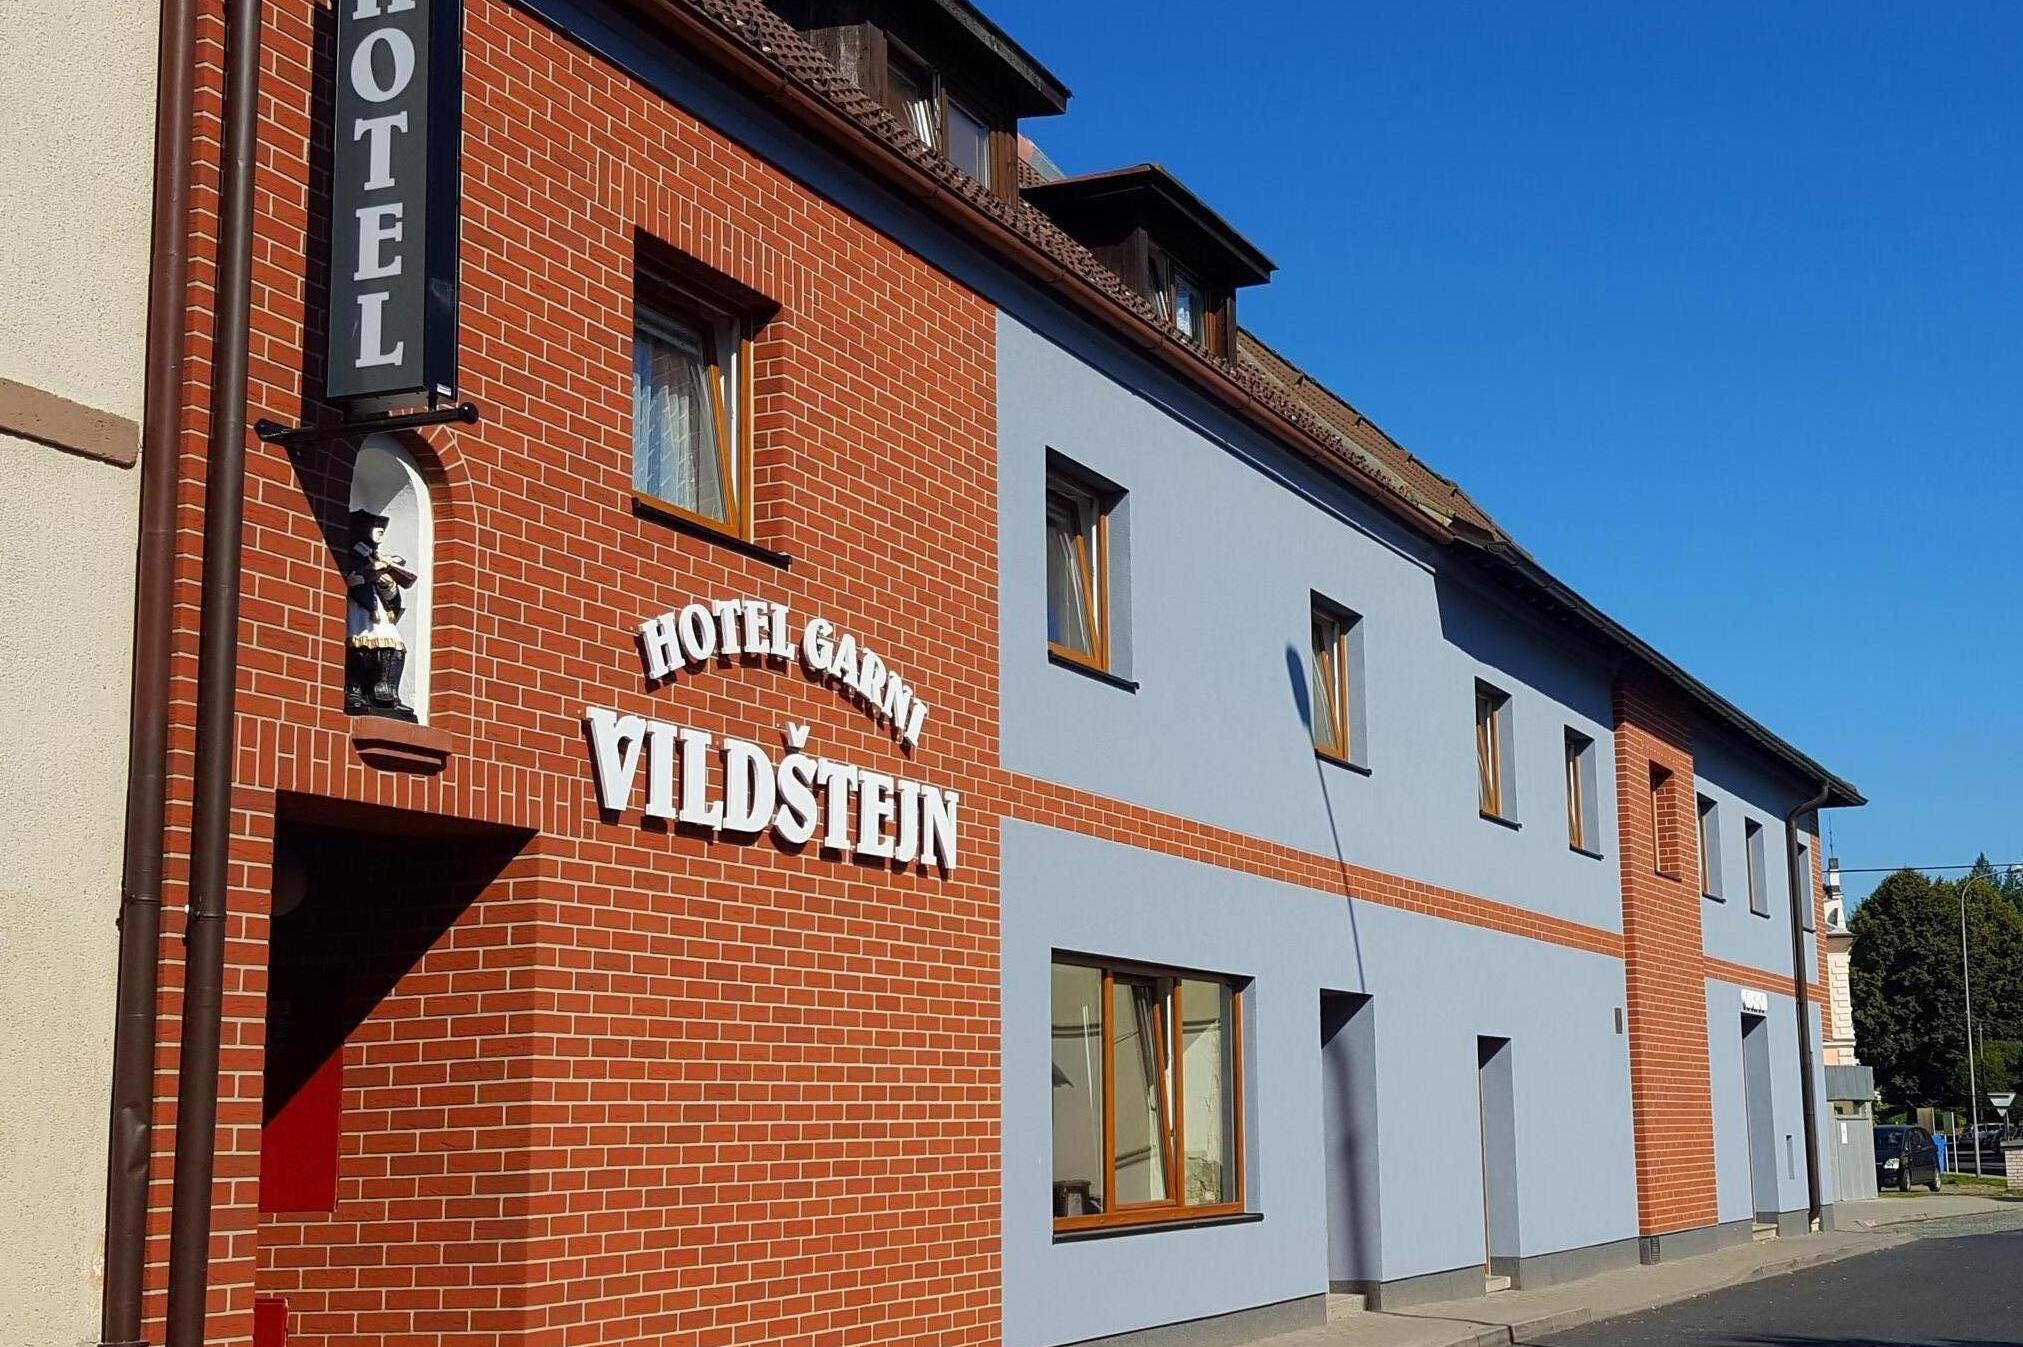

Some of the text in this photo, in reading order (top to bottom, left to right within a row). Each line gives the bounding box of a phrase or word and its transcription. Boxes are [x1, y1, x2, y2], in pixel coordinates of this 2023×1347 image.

[351, 0, 416, 368] OTEL
[639, 599, 928, 748] HOTEL GARNI
[585, 706, 960, 870] VILDŠTEJN
